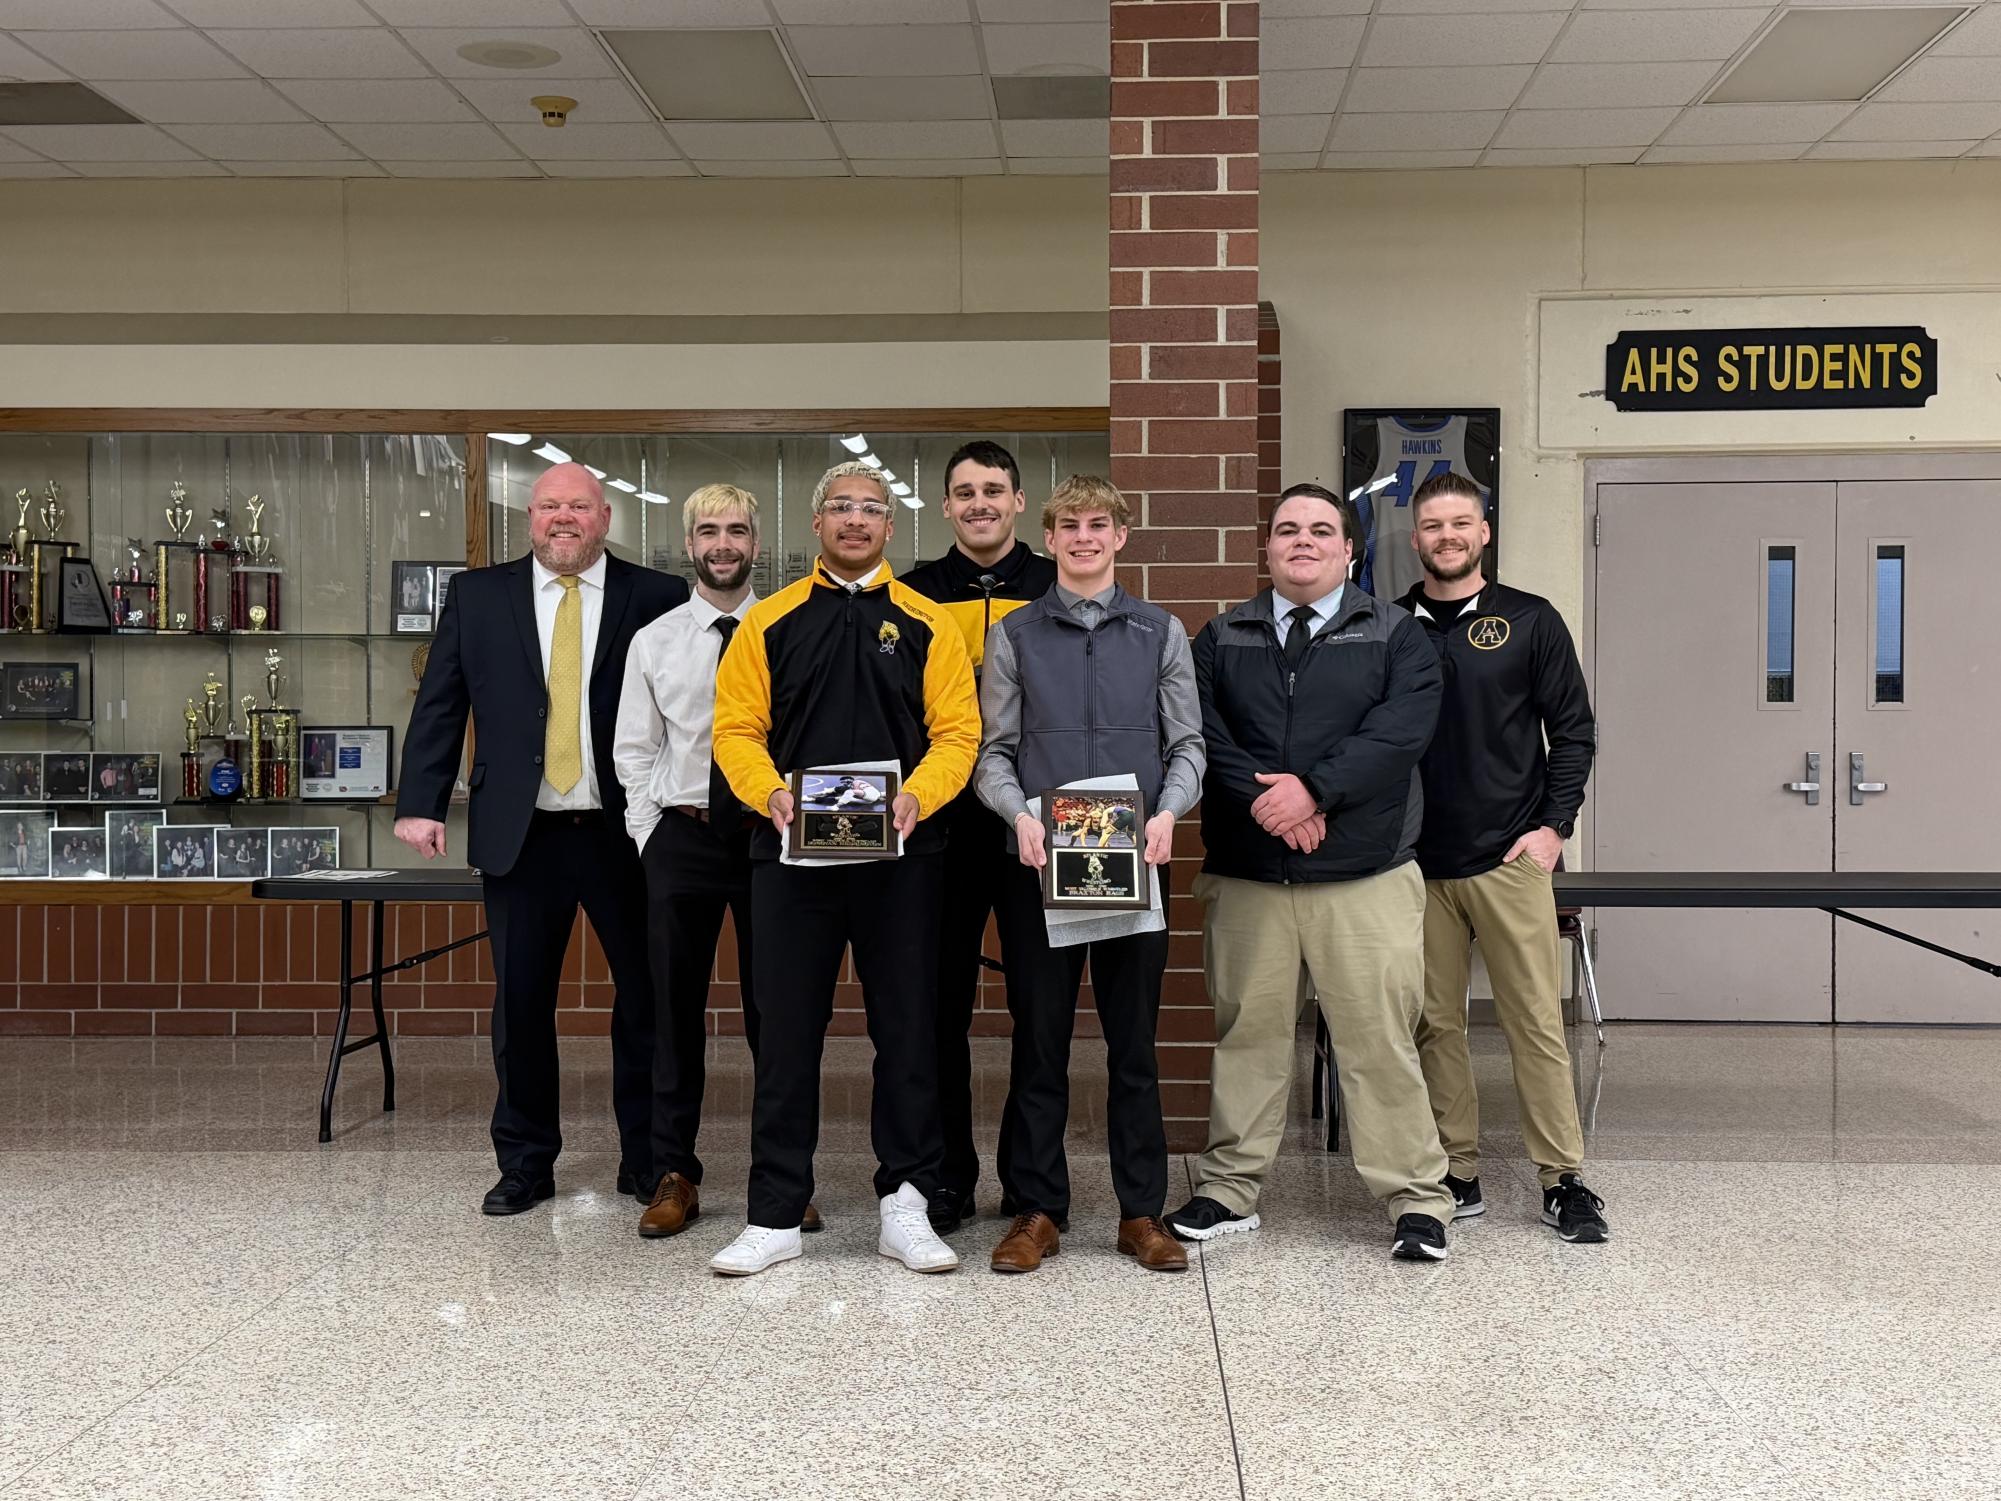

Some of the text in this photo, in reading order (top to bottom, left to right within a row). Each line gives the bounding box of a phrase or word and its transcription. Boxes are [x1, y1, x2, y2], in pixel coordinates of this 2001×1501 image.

[1620, 342, 1923, 393] AHS STUDENTS
[1401, 439, 1442, 455] HAWKINS
